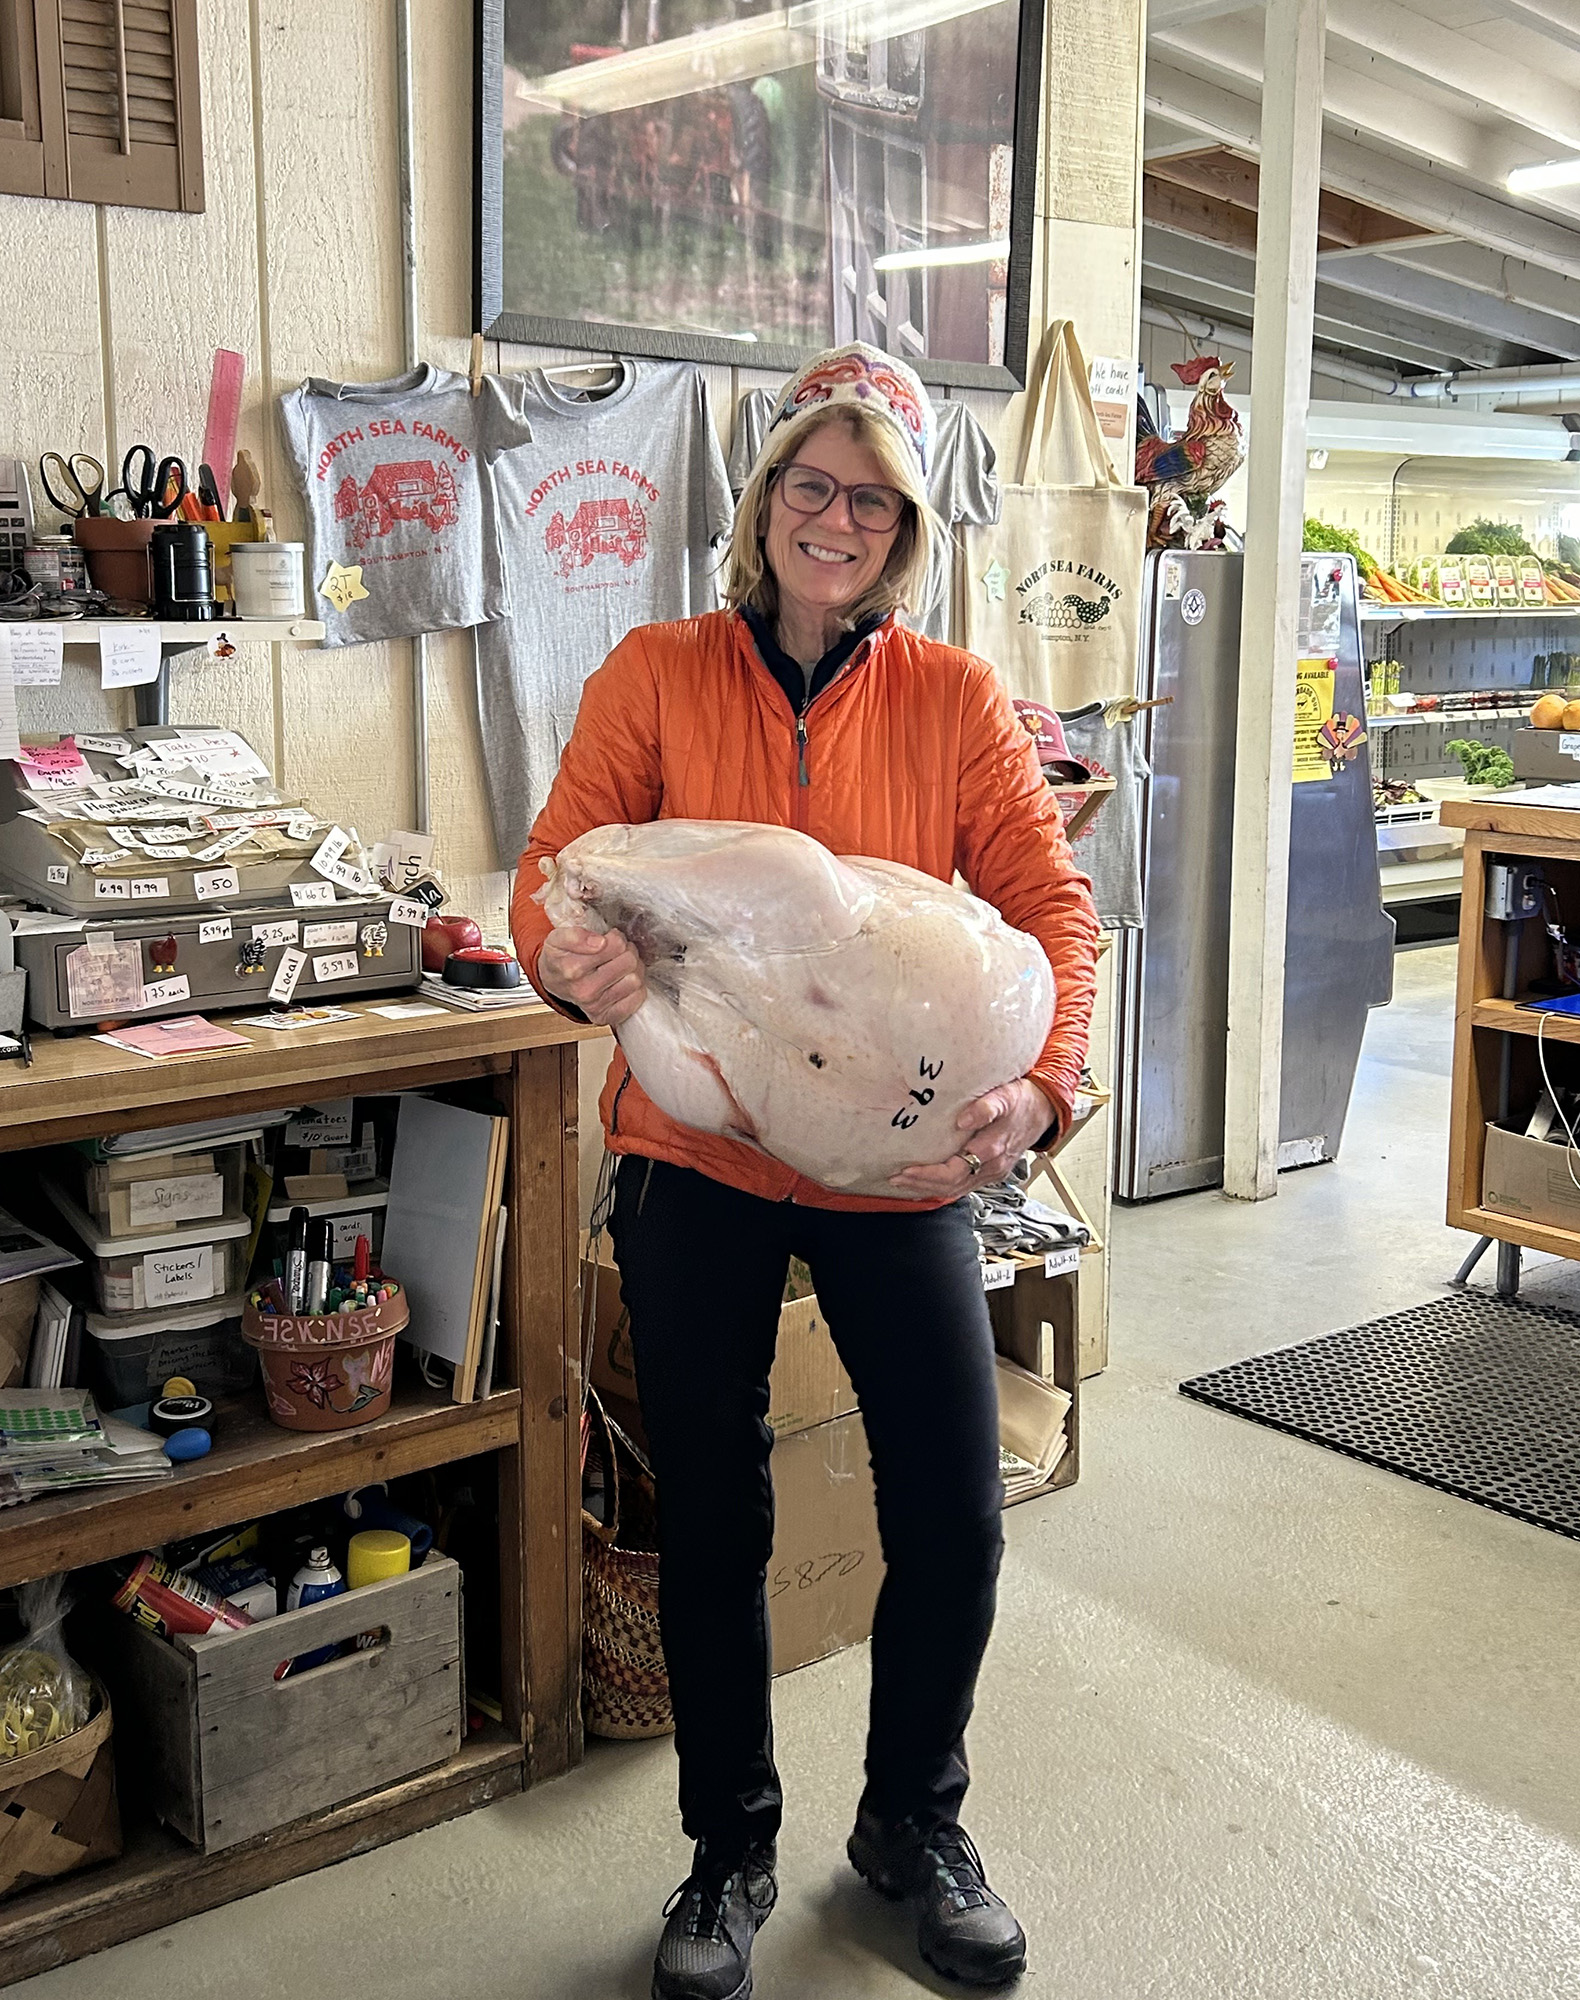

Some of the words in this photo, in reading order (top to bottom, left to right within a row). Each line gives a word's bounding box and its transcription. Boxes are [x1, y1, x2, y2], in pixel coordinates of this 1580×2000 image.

[1110, 363, 1129, 380] have
[316, 426, 364, 483] NORTH
[368, 419, 407, 438] SEA
[412, 420, 471, 464] FARMS
[525, 466, 571, 518] NORTH
[575, 459, 608, 476] SEA
[612, 461, 660, 503] FARMS
[359, 550, 428, 567] SOUTHAMPTON
[330, 573, 352, 593] 2T
[564, 582, 620, 593] SOUTHAMPTON
[1015, 562, 1048, 597] NORTH
[1050, 559, 1073, 574] SEA
[1076, 562, 1123, 600] FARMS
[1304, 671, 1330, 680] AVAILABLE
[82, 738, 123, 752] Local
[156, 779, 245, 807] Scallions
[84, 793, 159, 812] Hamburger
[99, 882, 124, 894] 6.99
[133, 882, 158, 894] 9.99
[397, 904, 418, 919] 5.99
[202, 924, 222, 936] 5.99
[261, 927, 284, 941] 3.25
[281, 933, 298, 943] each
[321, 959, 344, 977] 3.59
[275, 957, 300, 997] Local
[168, 988, 186, 998] each
[323, 1134, 350, 1143] Quart
[152, 1187, 192, 1209] Signs
[1047, 1252, 1079, 1271] Adult-XL
[164, 1271, 194, 1285] Labels
[291, 1256, 305, 1295] Sharpie
[983, 1270, 1012, 1287] Adult-L
